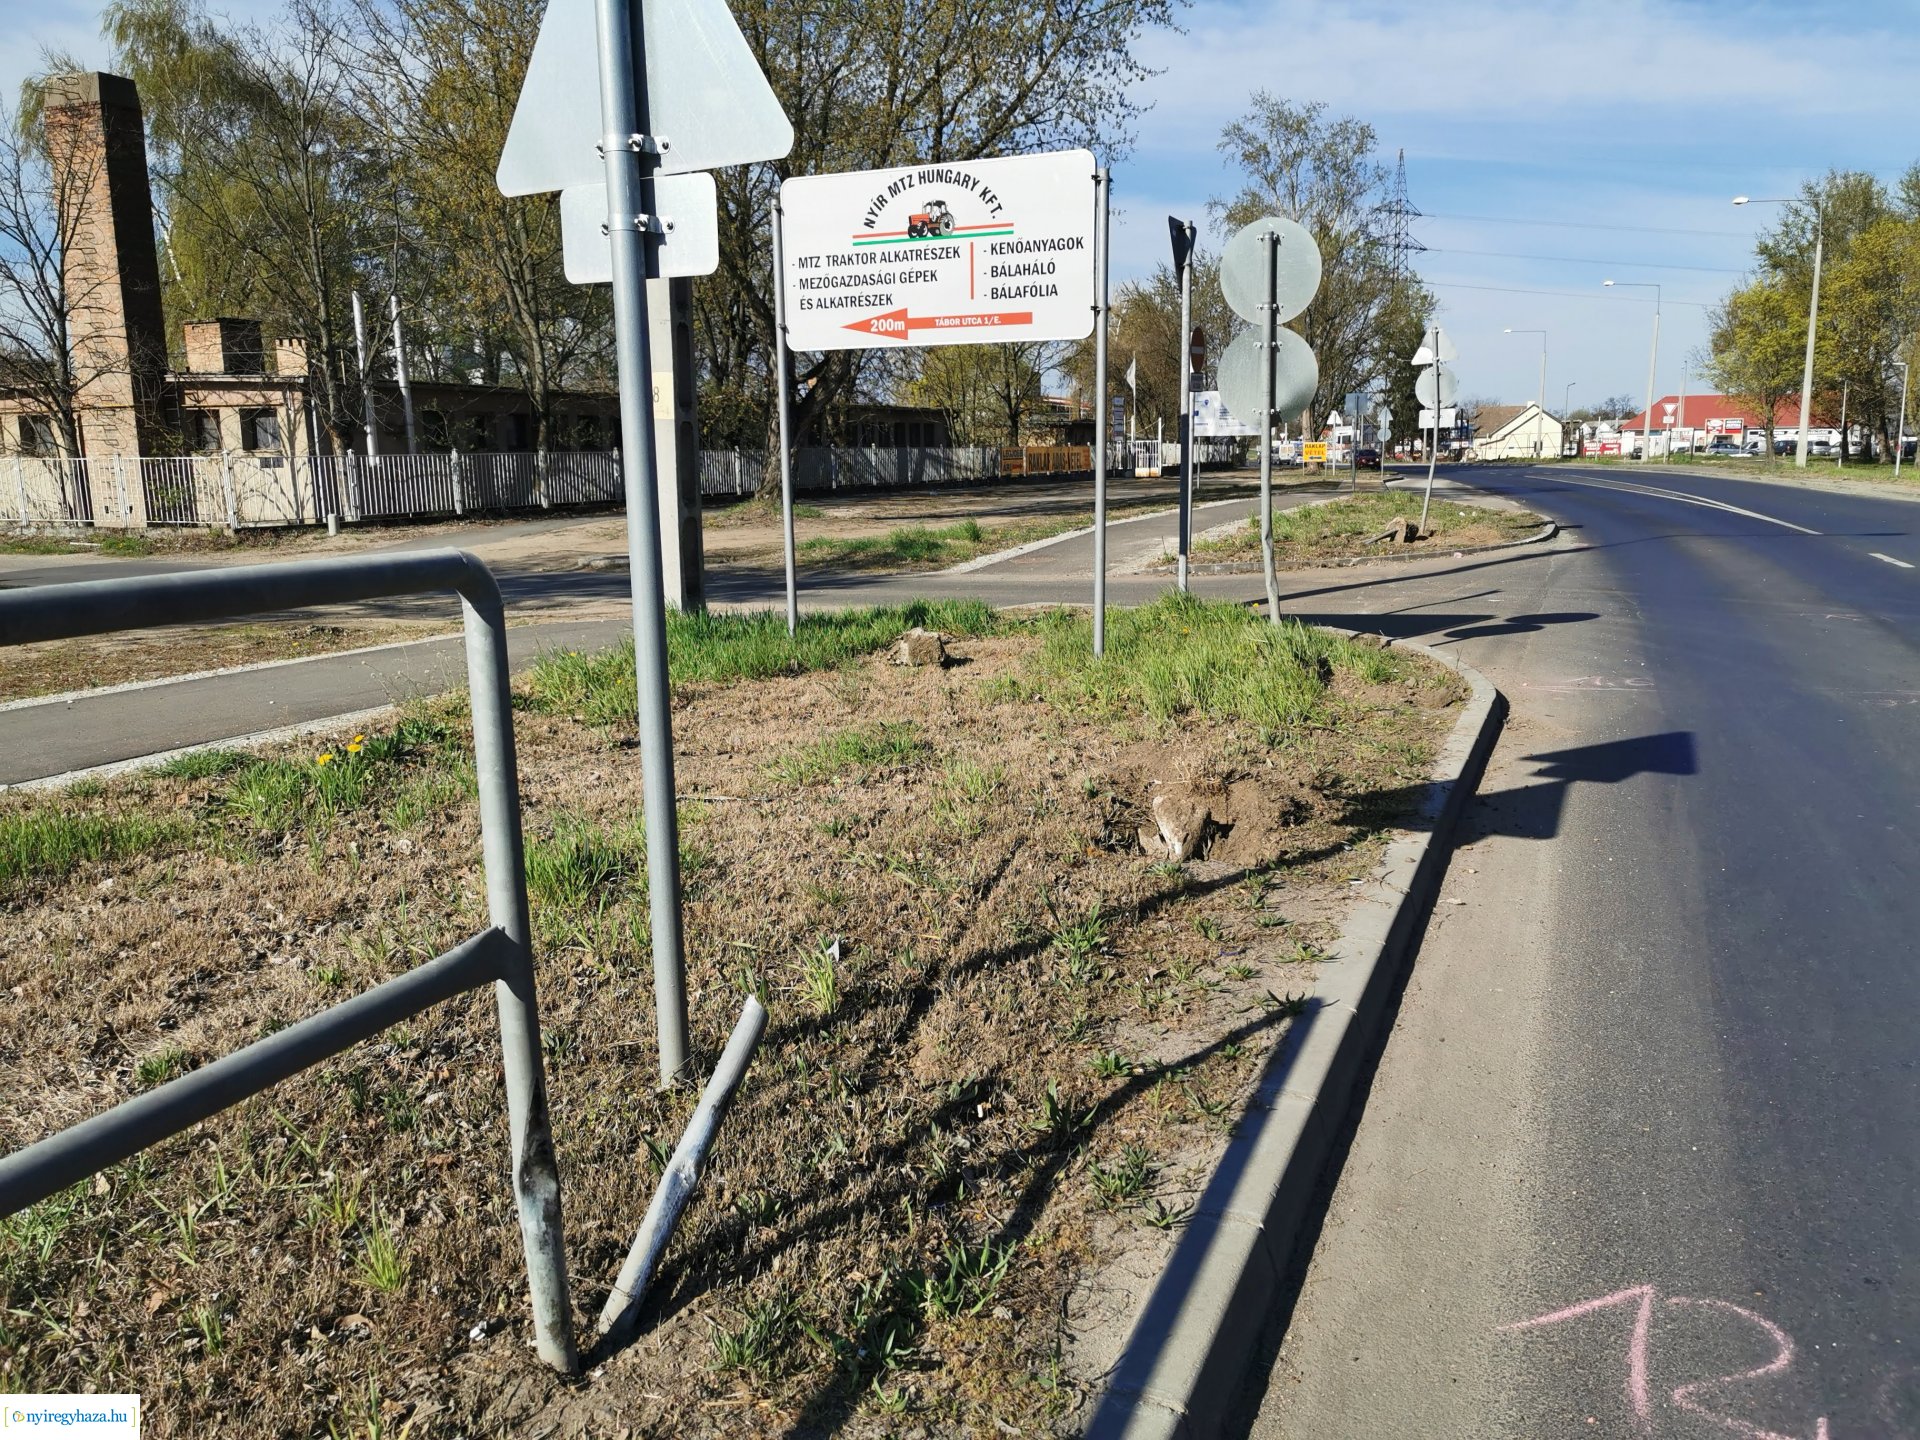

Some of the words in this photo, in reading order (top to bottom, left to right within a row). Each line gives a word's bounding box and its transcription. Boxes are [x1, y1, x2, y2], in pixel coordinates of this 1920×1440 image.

[864, 194, 888, 229] NYÍR
[887, 175, 915, 198] MTZ
[918, 169, 979, 192] HUNGARY
[979, 186, 1003, 219] KFT.
[991, 237, 1084, 255] KENŐANYAGOK
[798, 255, 820, 269] MTZ
[826, 252, 876, 267] TRAKTOR
[880, 244, 960, 264] ALKATRÉSZEK
[799, 269, 895, 290] MEZŐGAZDASÁGI
[899, 267, 938, 284] GÉPEK
[991, 261, 1056, 278] BÁLAHÁLÓ
[800, 295, 813, 310] ÉS
[816, 291, 893, 309] ALKATRÉSZEK
[991, 283, 1058, 300] BÁLAFÓLIA
[870, 319, 905, 332] 200m
[935, 315, 960, 326] TÁBOR
[962, 316, 981, 325] UTCA
